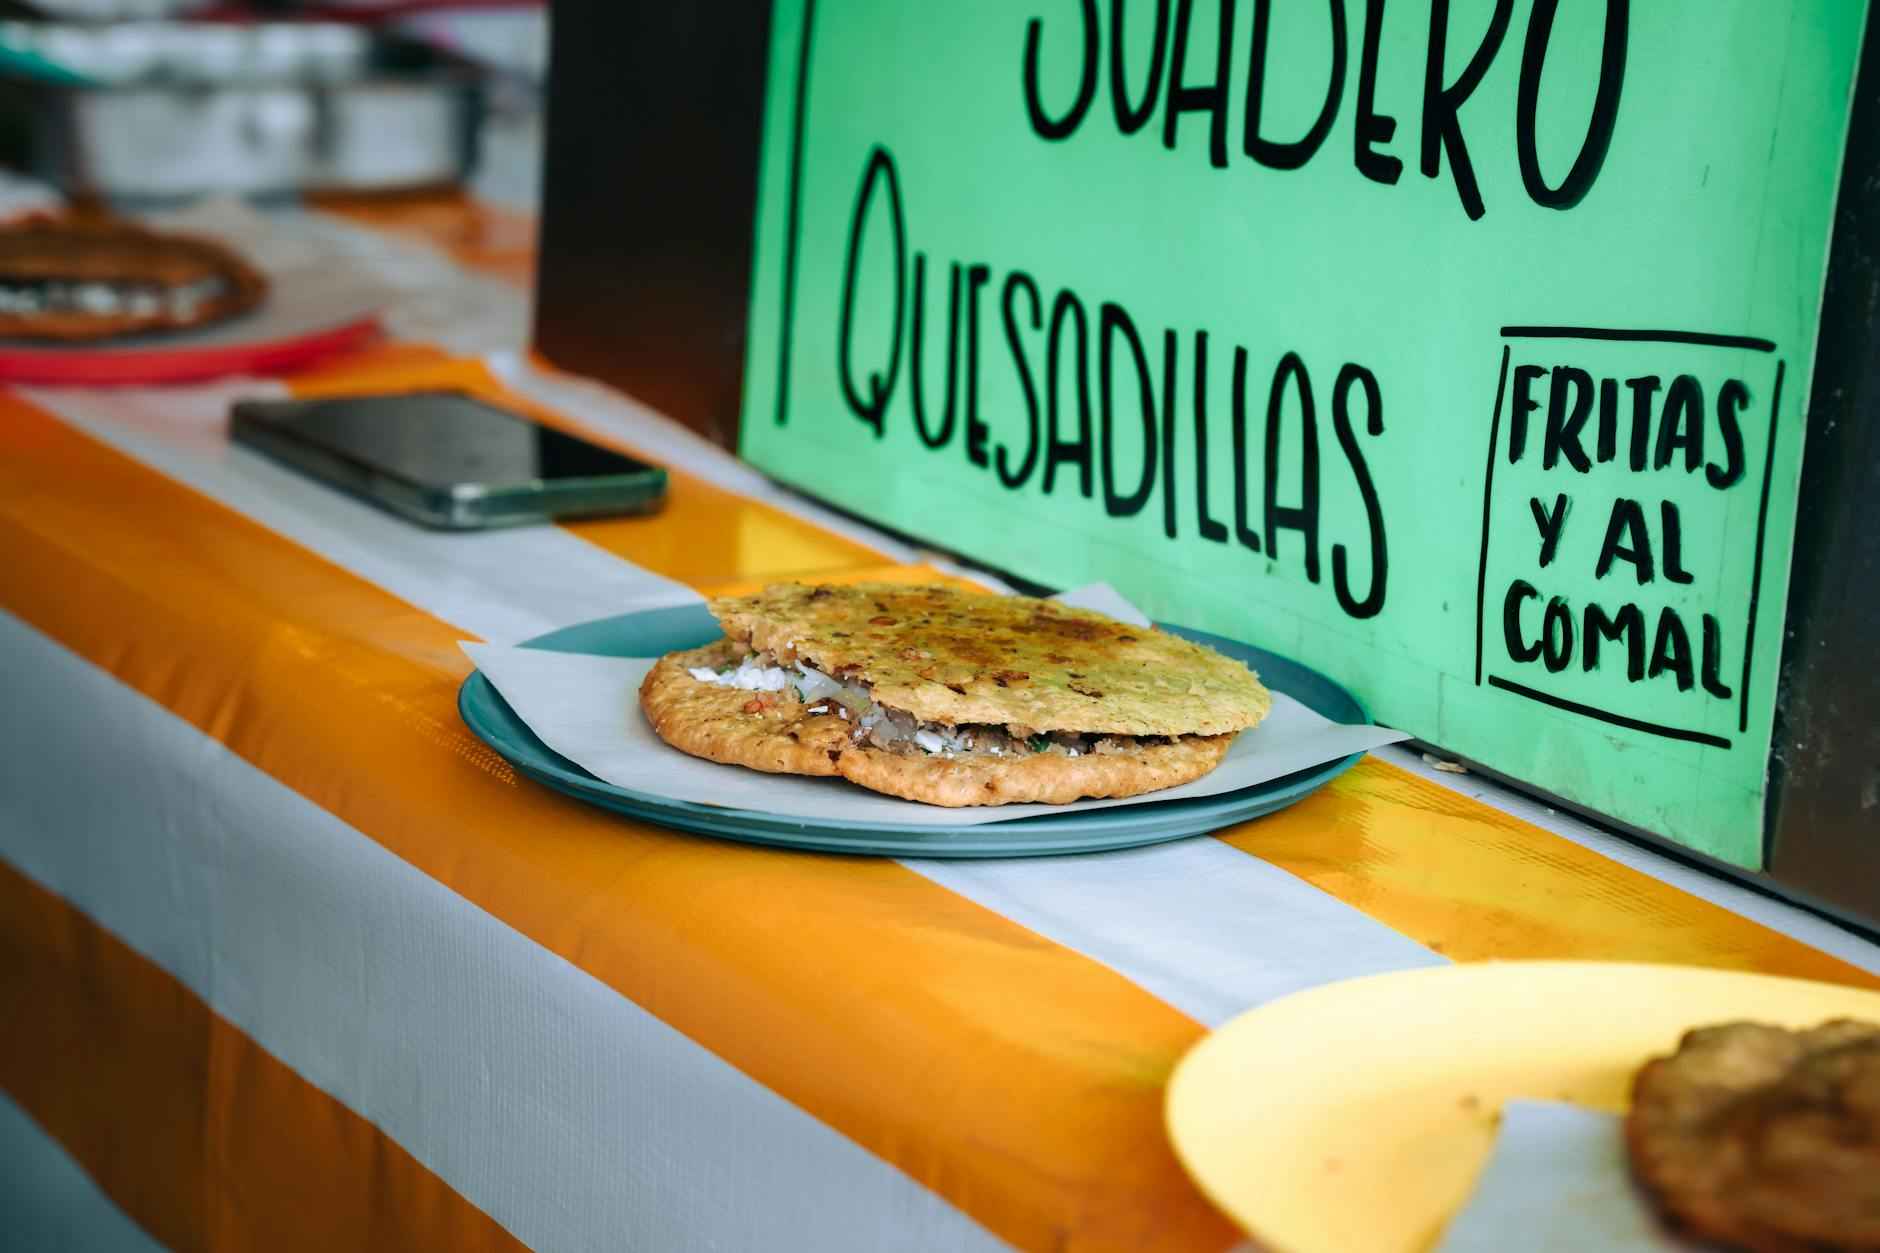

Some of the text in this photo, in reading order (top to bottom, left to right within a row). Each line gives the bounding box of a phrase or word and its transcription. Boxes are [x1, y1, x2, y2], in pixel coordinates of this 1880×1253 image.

[839, 146, 1389, 620] QUESADILLAS
[1508, 365, 1751, 491] FRITAS
[1529, 493, 1695, 586] Y AL
[1502, 578, 1733, 700] COMAL
